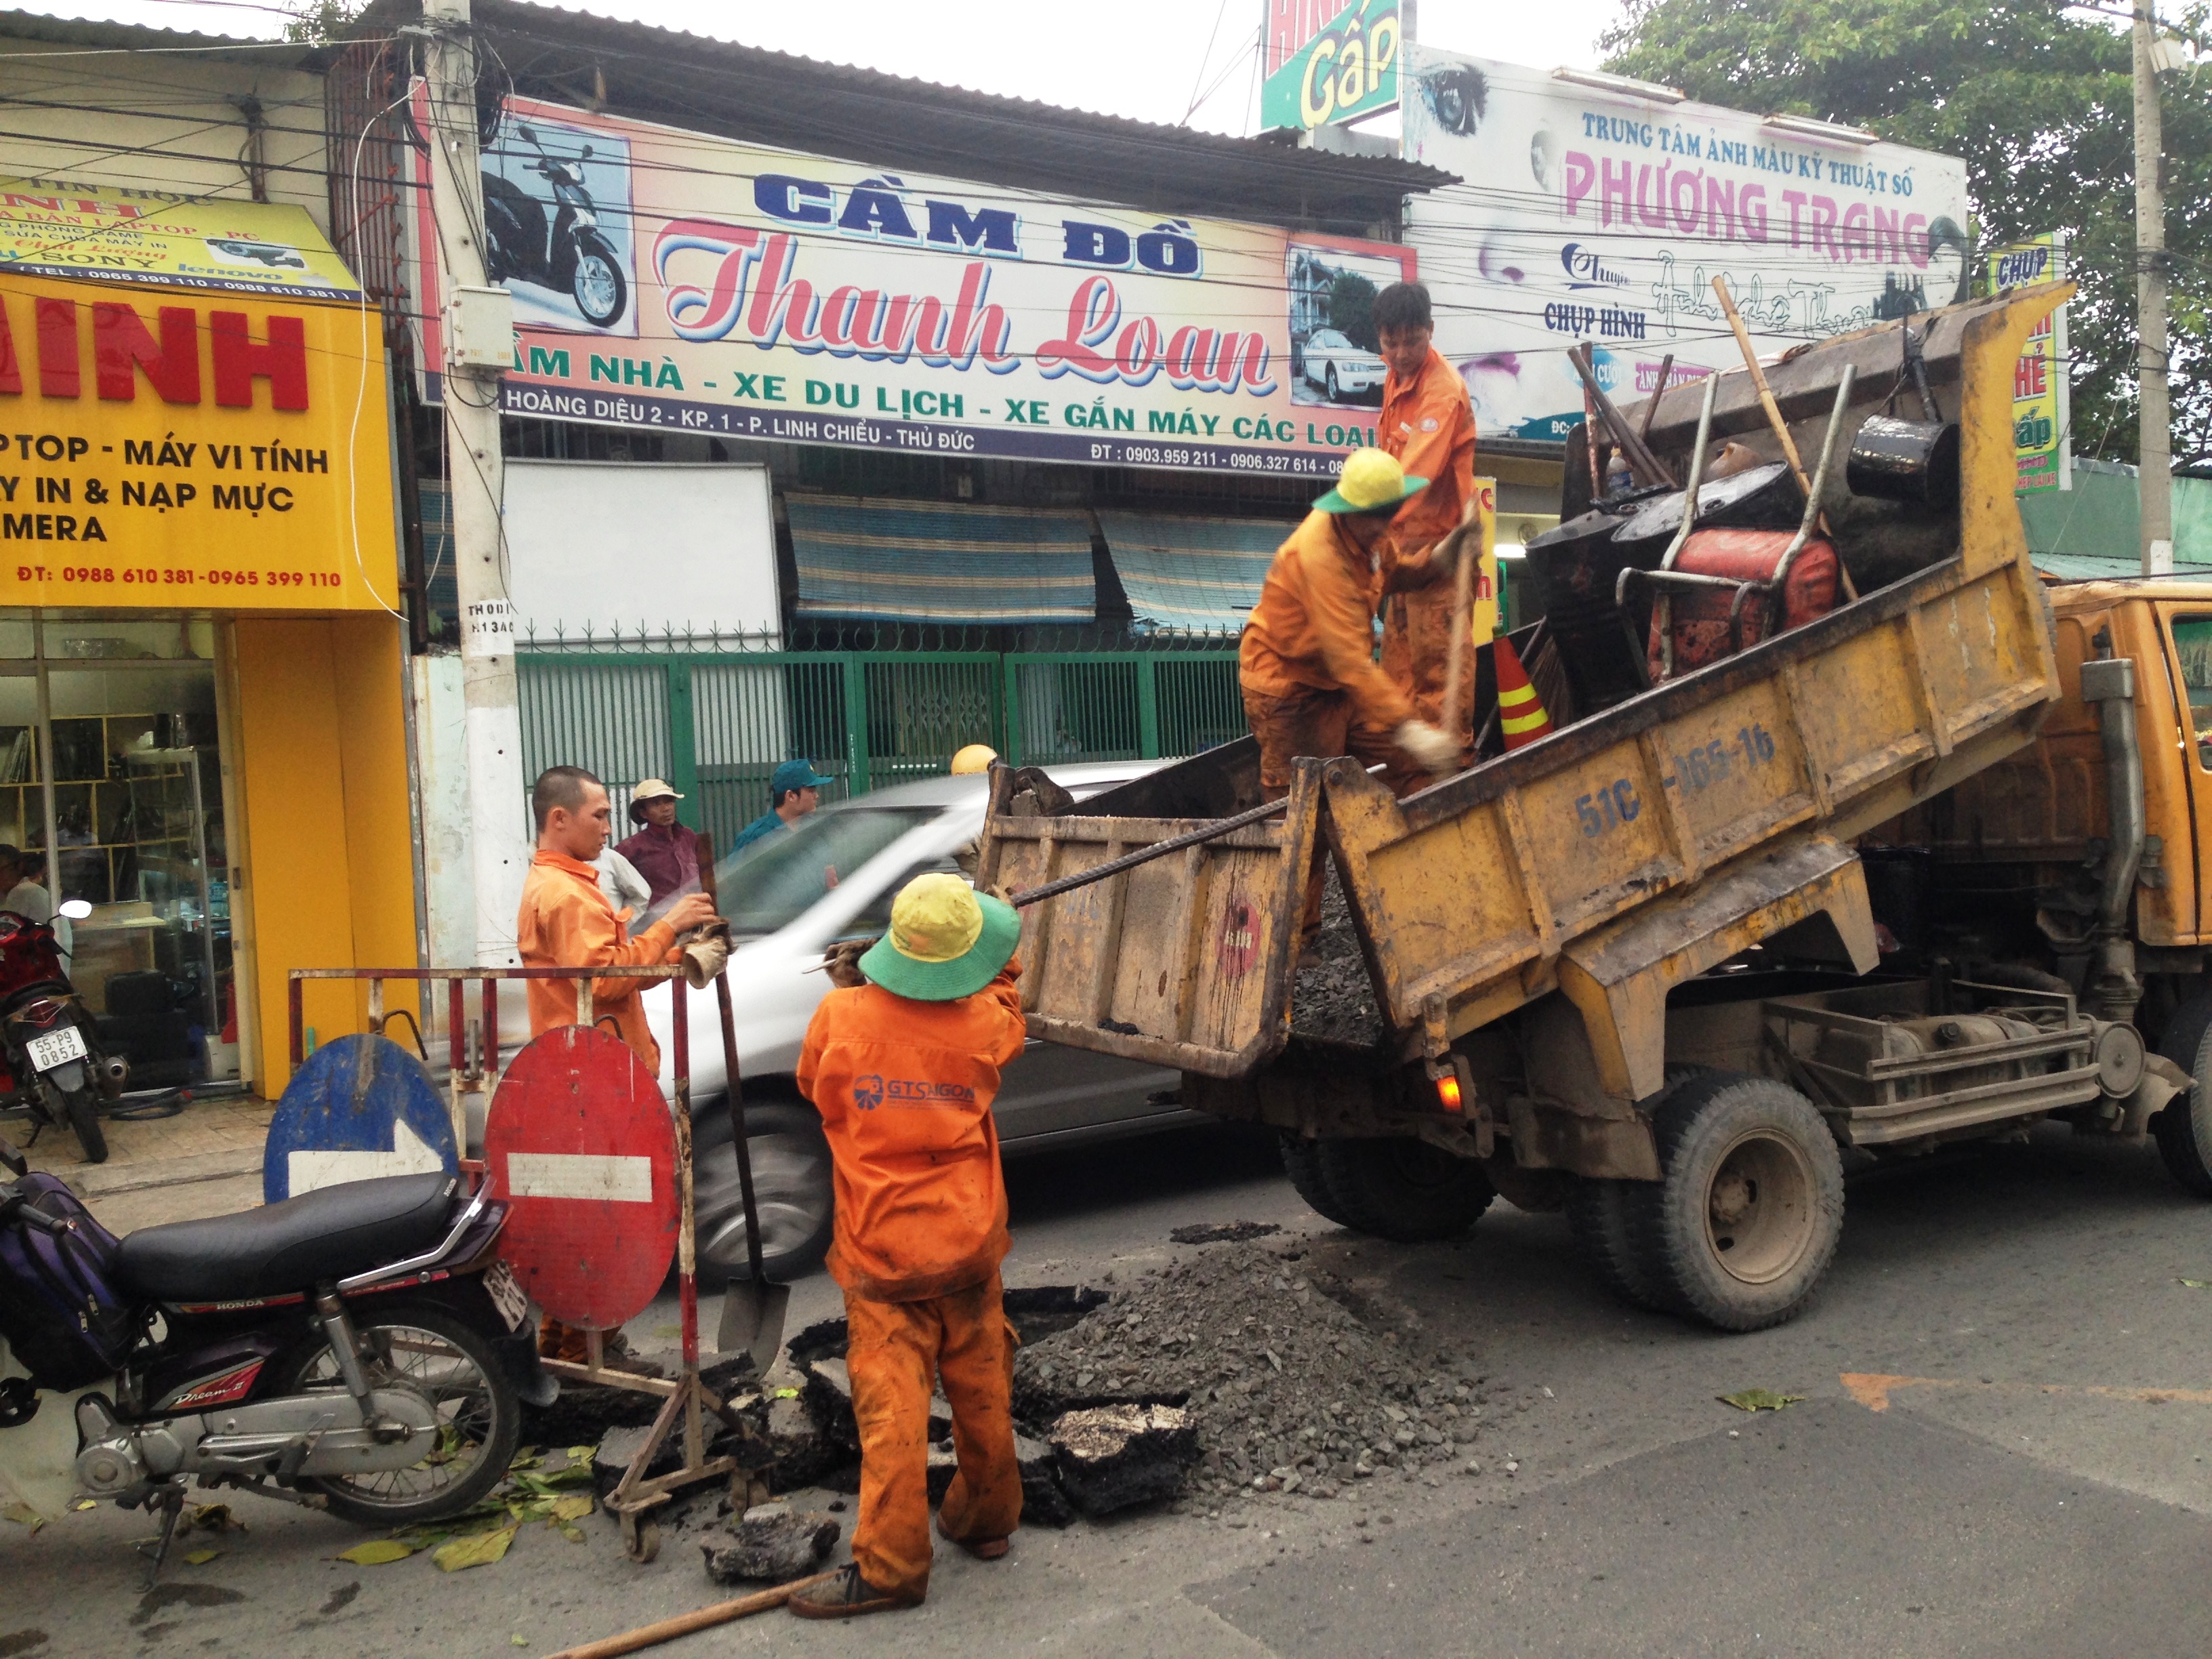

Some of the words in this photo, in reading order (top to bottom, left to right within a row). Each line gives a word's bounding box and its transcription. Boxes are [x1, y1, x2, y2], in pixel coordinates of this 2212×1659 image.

[1583, 112, 1653, 148] TRUNG
[1659, 123, 1701, 157] TÂM
[1707, 128, 1746, 165] ẢNH
[1828, 161, 1887, 195] THUẬT
[1892, 167, 1916, 197] SỐ
[93, 218, 197, 234] LAPTOP
[225, 231, 260, 241] PC
[754, 173, 1022, 259] CẦM
[1062, 220, 1203, 279] ĐỒ
[1564, 150, 1767, 244] PHƯƠNG
[1782, 189, 1930, 269] TRANG
[32, 266, 71, 276] TEL
[89, 271, 132, 281] 0965
[138, 274, 169, 284] 399
[176, 277, 207, 286] 110
[224, 282, 266, 291] 0988
[271, 286, 302, 295] 610
[307, 290, 336, 298] 381
[41, 252, 157, 268] SONY
[179, 263, 283, 280] lenovo
[1997, 247, 2047, 287] CHỤP
[652, 217, 1021, 378] Thanh
[1036, 275, 1278, 398] Loan
[1544, 302, 1595, 338] CHỤP
[1600, 302, 1645, 339] HÌNH
[0, 293, 309, 410] INH
[590, 355, 684, 391] NHÀ
[733, 371, 786, 401] XE
[805, 380, 860, 408] DU
[877, 387, 963, 419] LỊCH
[1005, 398, 1049, 424] XE
[1064, 395, 1134, 431] GẮN
[1149, 407, 1220, 436] MÁY
[1233, 413, 1295, 442] CÁC
[506, 390, 586, 415] HOÀNG
[594, 398, 644, 424] DIỆU
[651, 407, 662, 423] 2
[681, 409, 714, 428] KP.
[721, 414, 729, 429] 1
[750, 419, 767, 434] P.
[774, 420, 817, 438] LINH
[824, 419, 880, 443] CHIỂU
[897, 426, 933, 447] THỦ
[938, 430, 975, 450] ĐỨC
[2013, 407, 2051, 448] ấp
[125, 431, 197, 467] MÁY
[207, 444, 242, 470] VI
[251, 438, 328, 473] TÍNH
[1126, 447, 1189, 464] 0903.959
[1193, 451, 1216, 466] 211
[1231, 454, 1289, 470] 0906.327
[1294, 458, 1317, 472] 614
[36, 477, 70, 503] IN
[85, 478, 109, 504] &
[122, 480, 196, 513] NẠP
[213, 483, 293, 517] MỰC
[18, 566, 52, 581] ĐT:
[63, 567, 115, 582] 0988
[123, 569, 157, 583] 610
[164, 569, 194, 583] 381
[208, 570, 258, 585] 0965
[266, 571, 303, 586] 399
[310, 573, 341, 587] 110
[1575, 779, 1640, 838] 51C
[41, 1044, 79, 1065] 0852
[217, 1300, 265, 1310] HONDA
[173, 1388, 229, 1404] Dream
